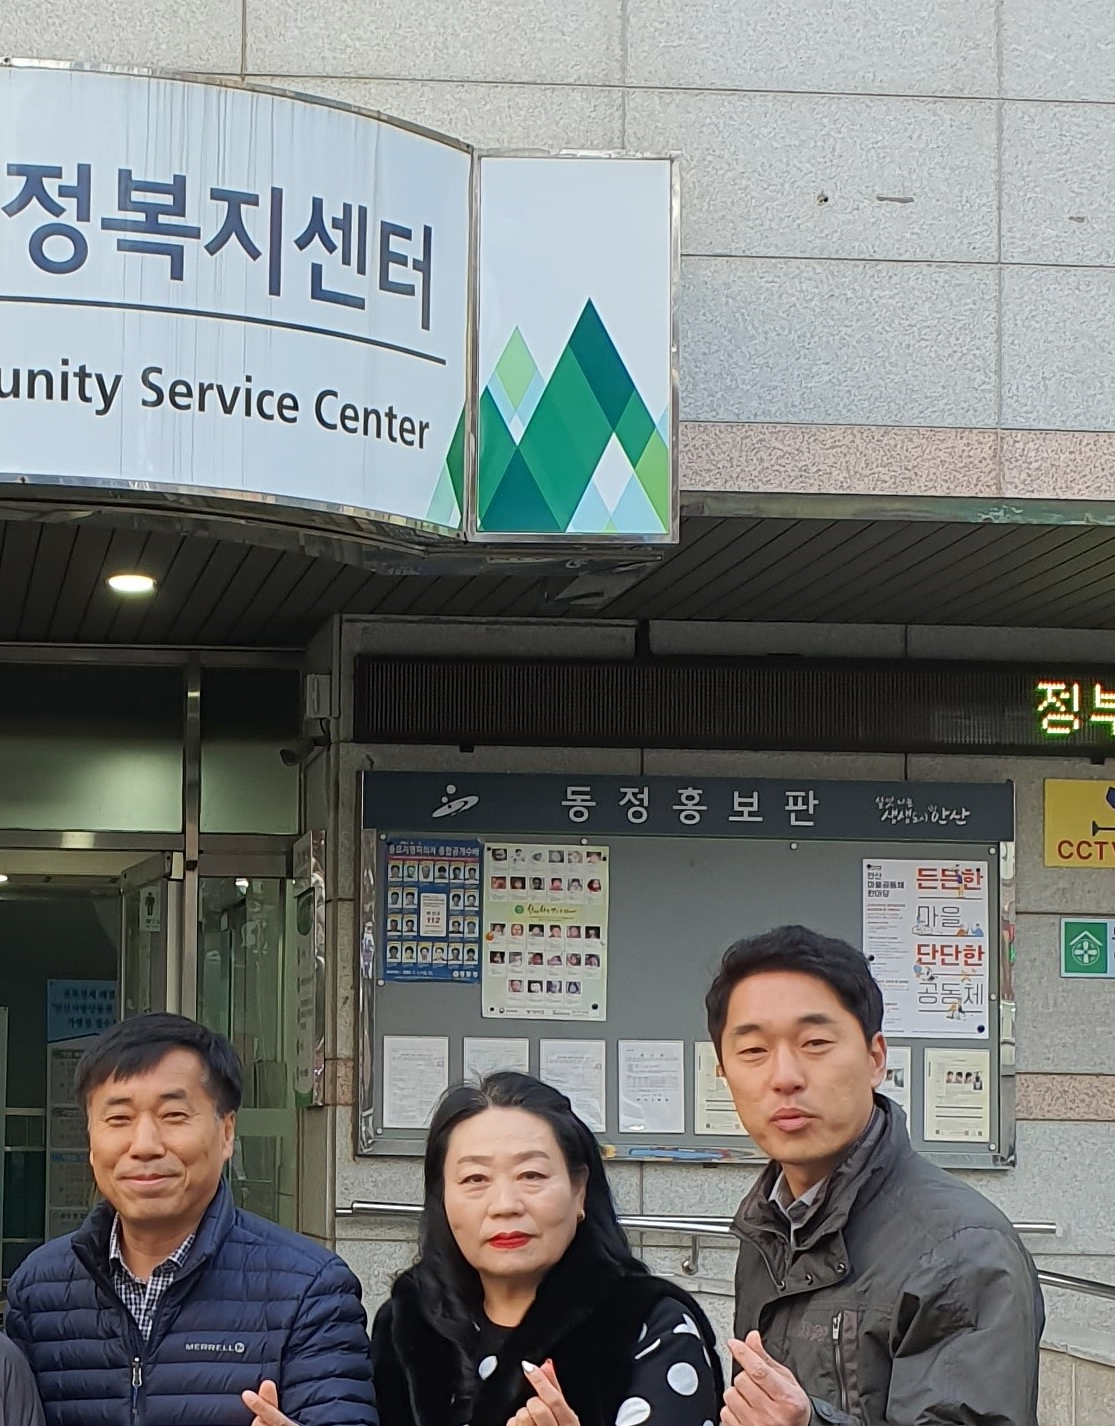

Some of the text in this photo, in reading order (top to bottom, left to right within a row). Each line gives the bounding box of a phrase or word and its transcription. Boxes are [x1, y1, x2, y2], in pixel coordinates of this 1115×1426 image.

[140, 366, 300, 423] Service
[314, 390, 430, 449] Center
[1057, 840, 1115, 860] CCT
[916, 866, 983, 890] 든든한
[917, 905, 961, 928] 마을
[916, 943, 985, 967] 단단한
[917, 982, 984, 1005] 공동체
[185, 1343, 234, 1352] MERRELL
